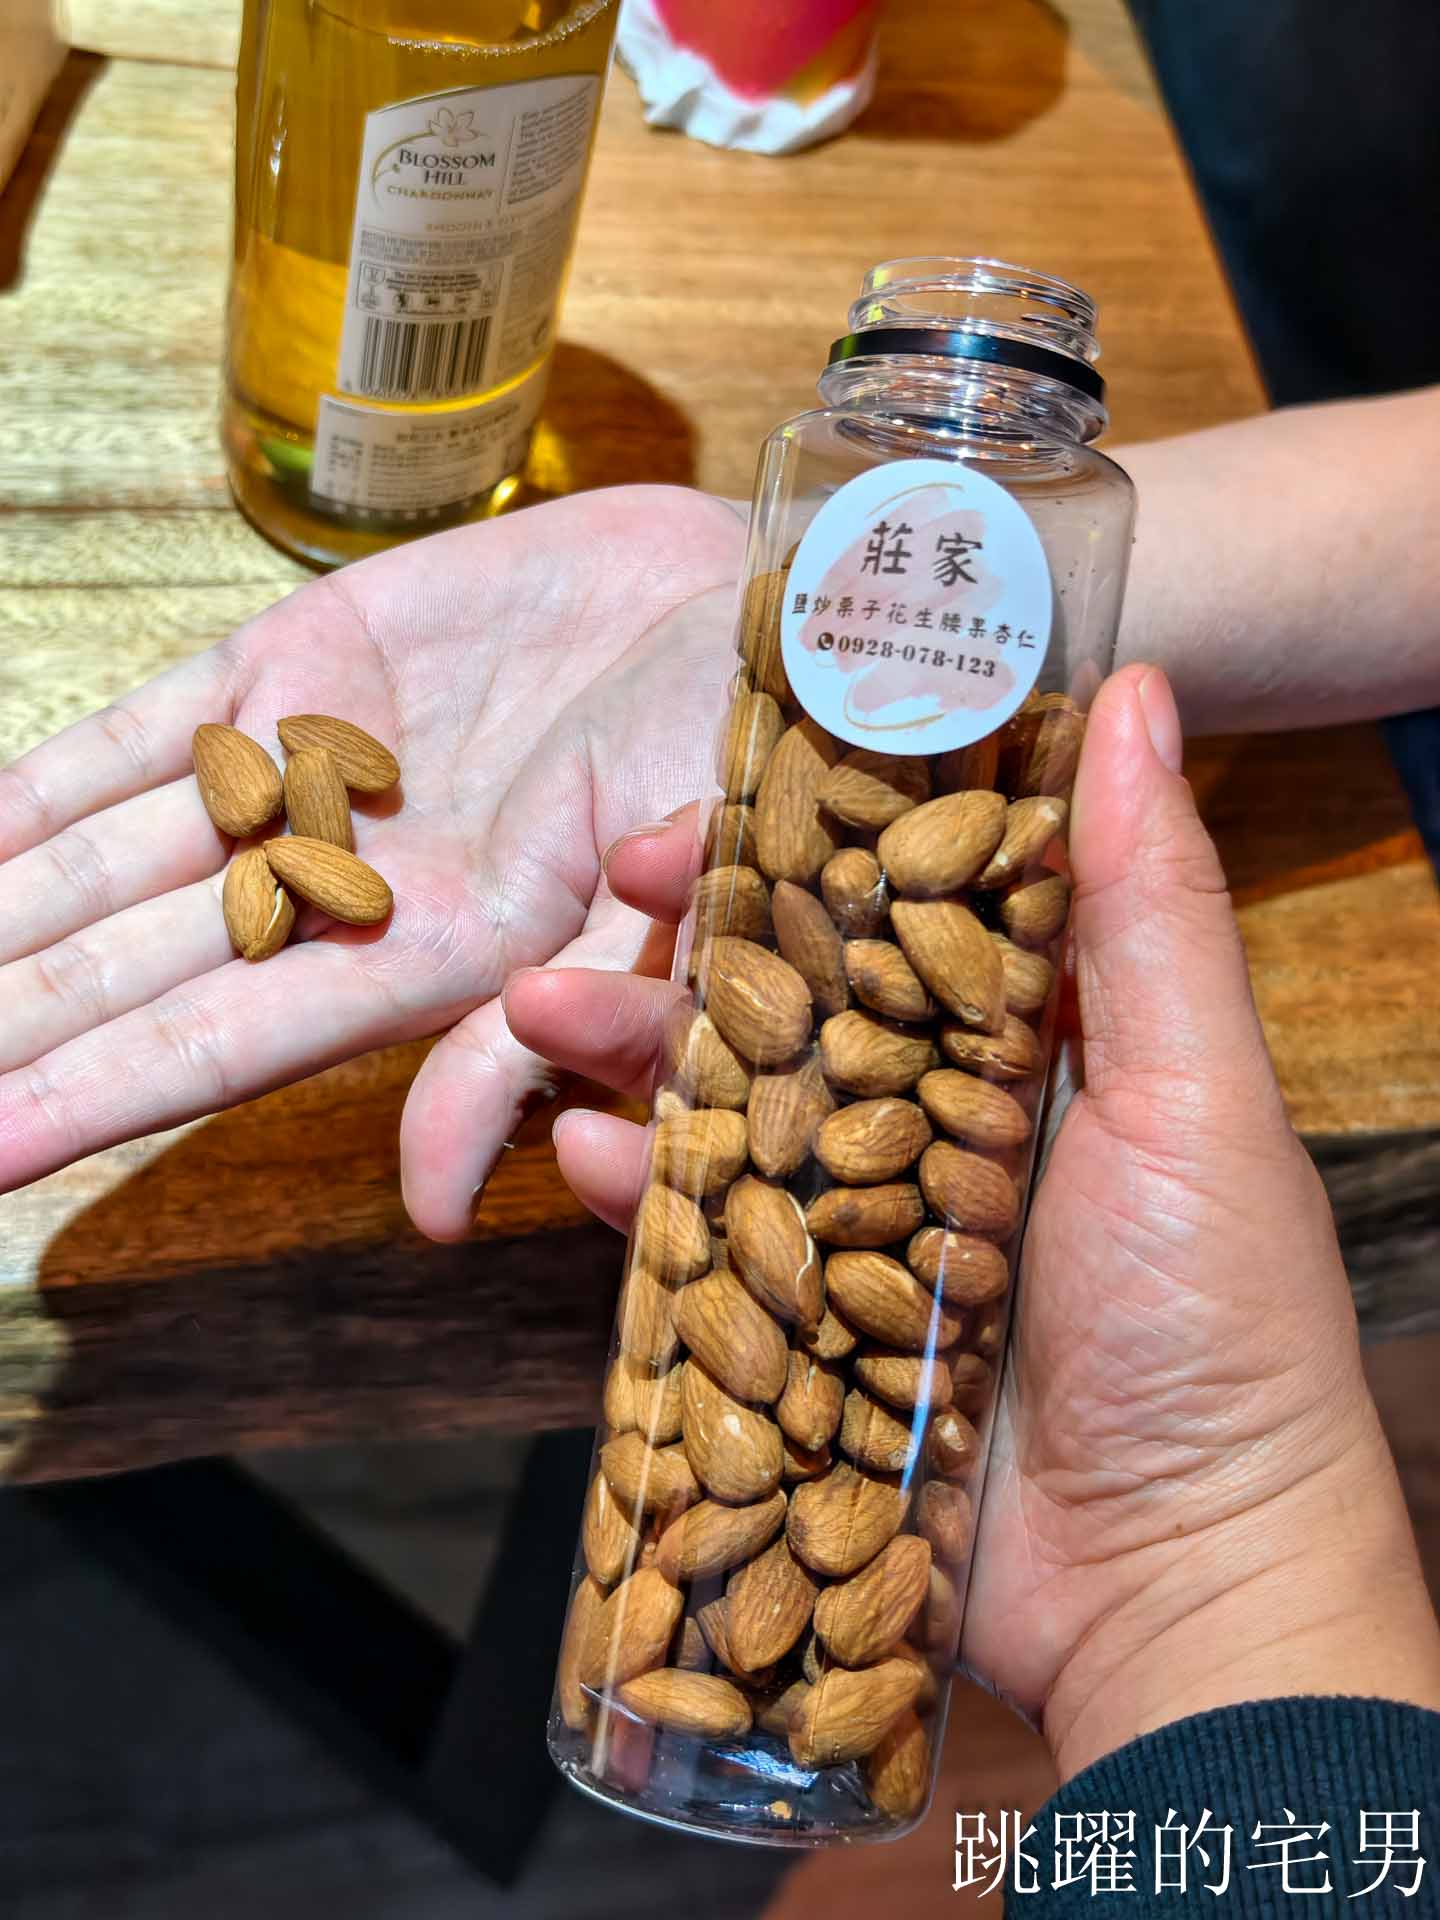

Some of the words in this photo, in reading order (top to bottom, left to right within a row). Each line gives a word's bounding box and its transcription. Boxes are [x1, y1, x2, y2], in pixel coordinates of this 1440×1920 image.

[399, 149, 496, 169] BLOSSOM
[423, 170, 468, 186] HILL
[386, 185, 493, 201] CHARDONNAY
[860, 520, 984, 588] 莊家
[838, 634, 997, 679] 0928-078-123
